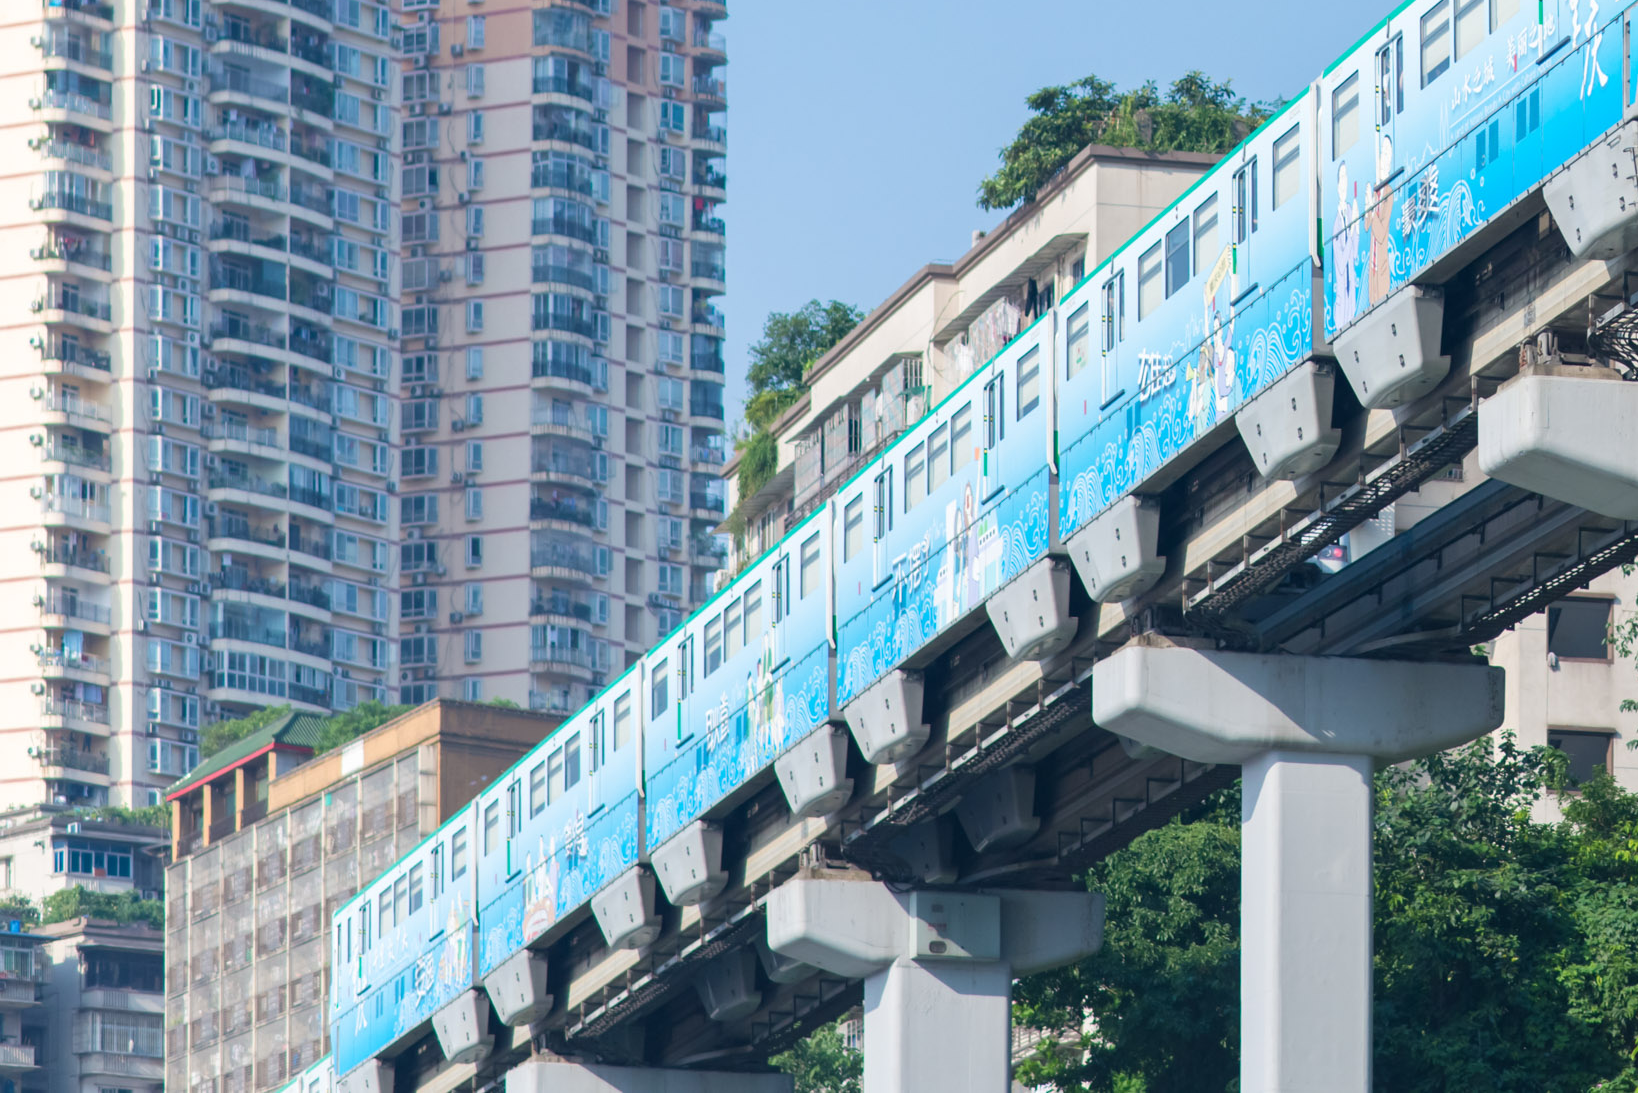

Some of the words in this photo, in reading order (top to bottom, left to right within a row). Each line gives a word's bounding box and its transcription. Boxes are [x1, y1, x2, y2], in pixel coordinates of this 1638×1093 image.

[1451, 54, 1495, 110] 山水之城
[1137, 347, 1177, 402] 雄起
